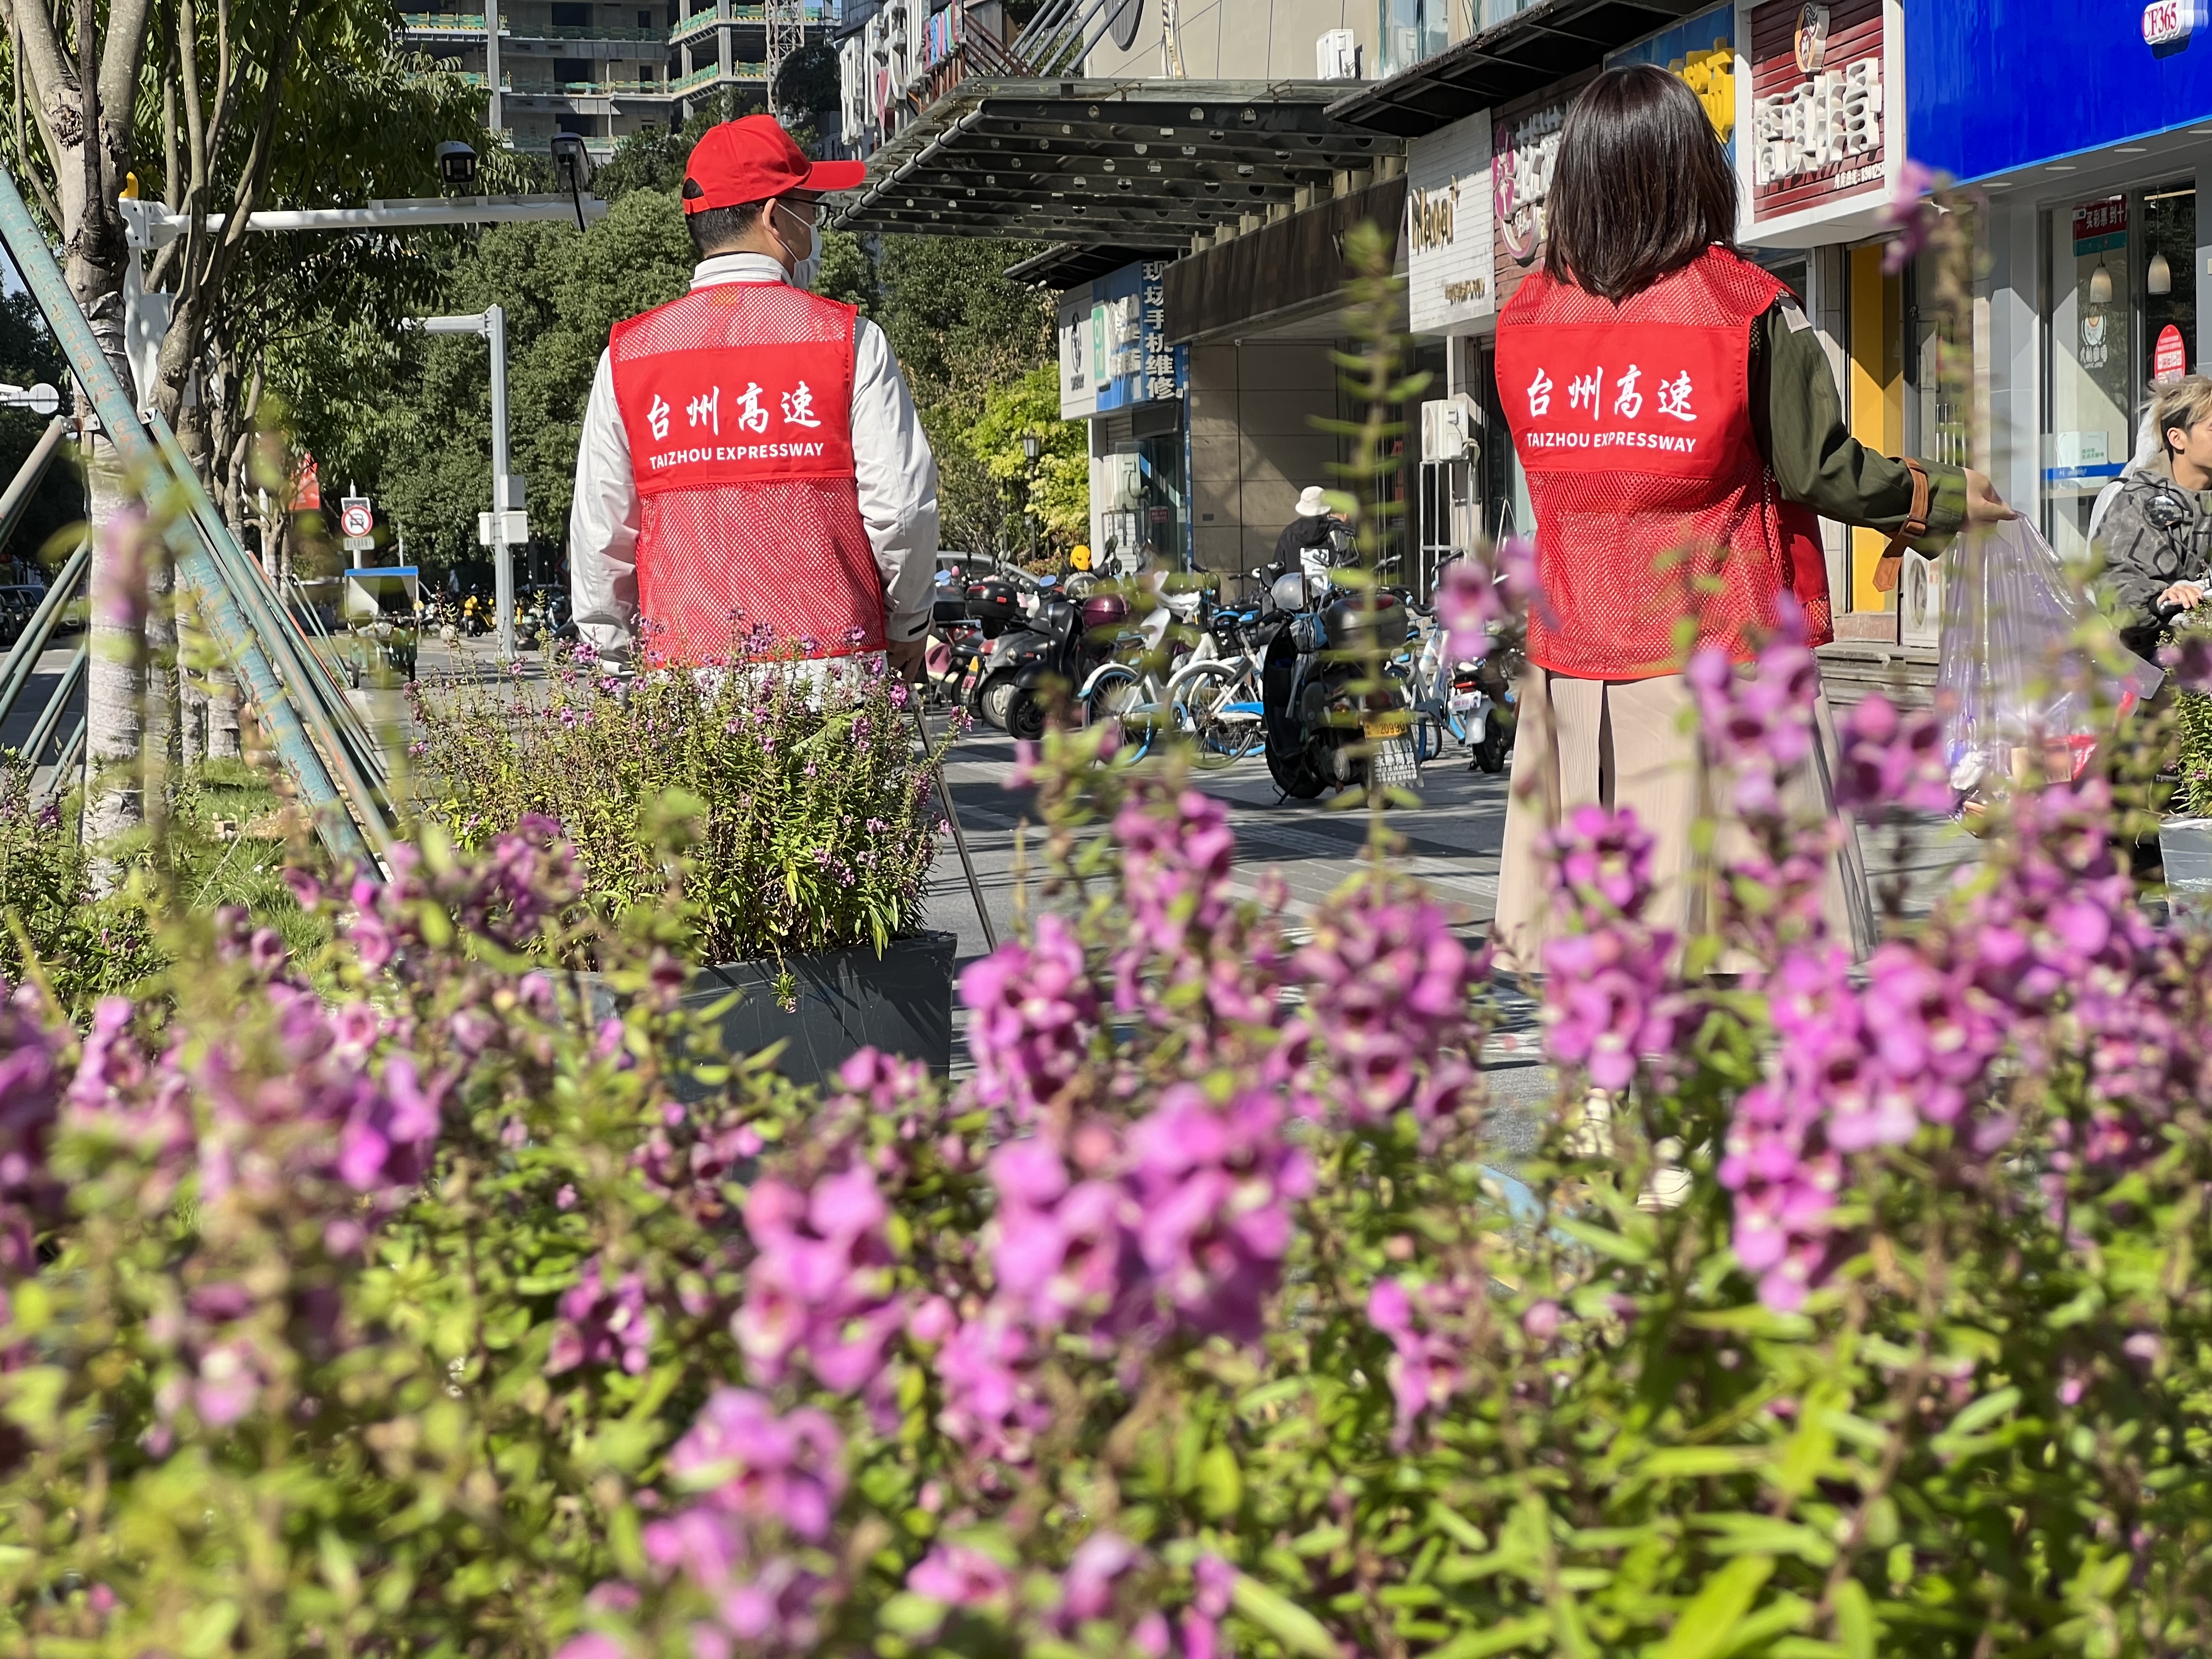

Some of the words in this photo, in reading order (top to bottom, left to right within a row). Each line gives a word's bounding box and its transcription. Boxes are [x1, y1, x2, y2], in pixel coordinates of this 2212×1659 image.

[2142, 2, 2177, 38] CF365
[1143, 260, 1176, 400] 现场手机维修
[647, 380, 821, 441] 台州高速
[1527, 364, 1697, 421] 台州高速
[650, 447, 712, 470] TAIZHOU
[716, 443, 823, 460] EXPRESSWAY
[1527, 432, 1589, 448] TAIZHOU
[1594, 431, 1696, 453] EXPRESSWAY
[1380, 721, 1405, 734] 20990
